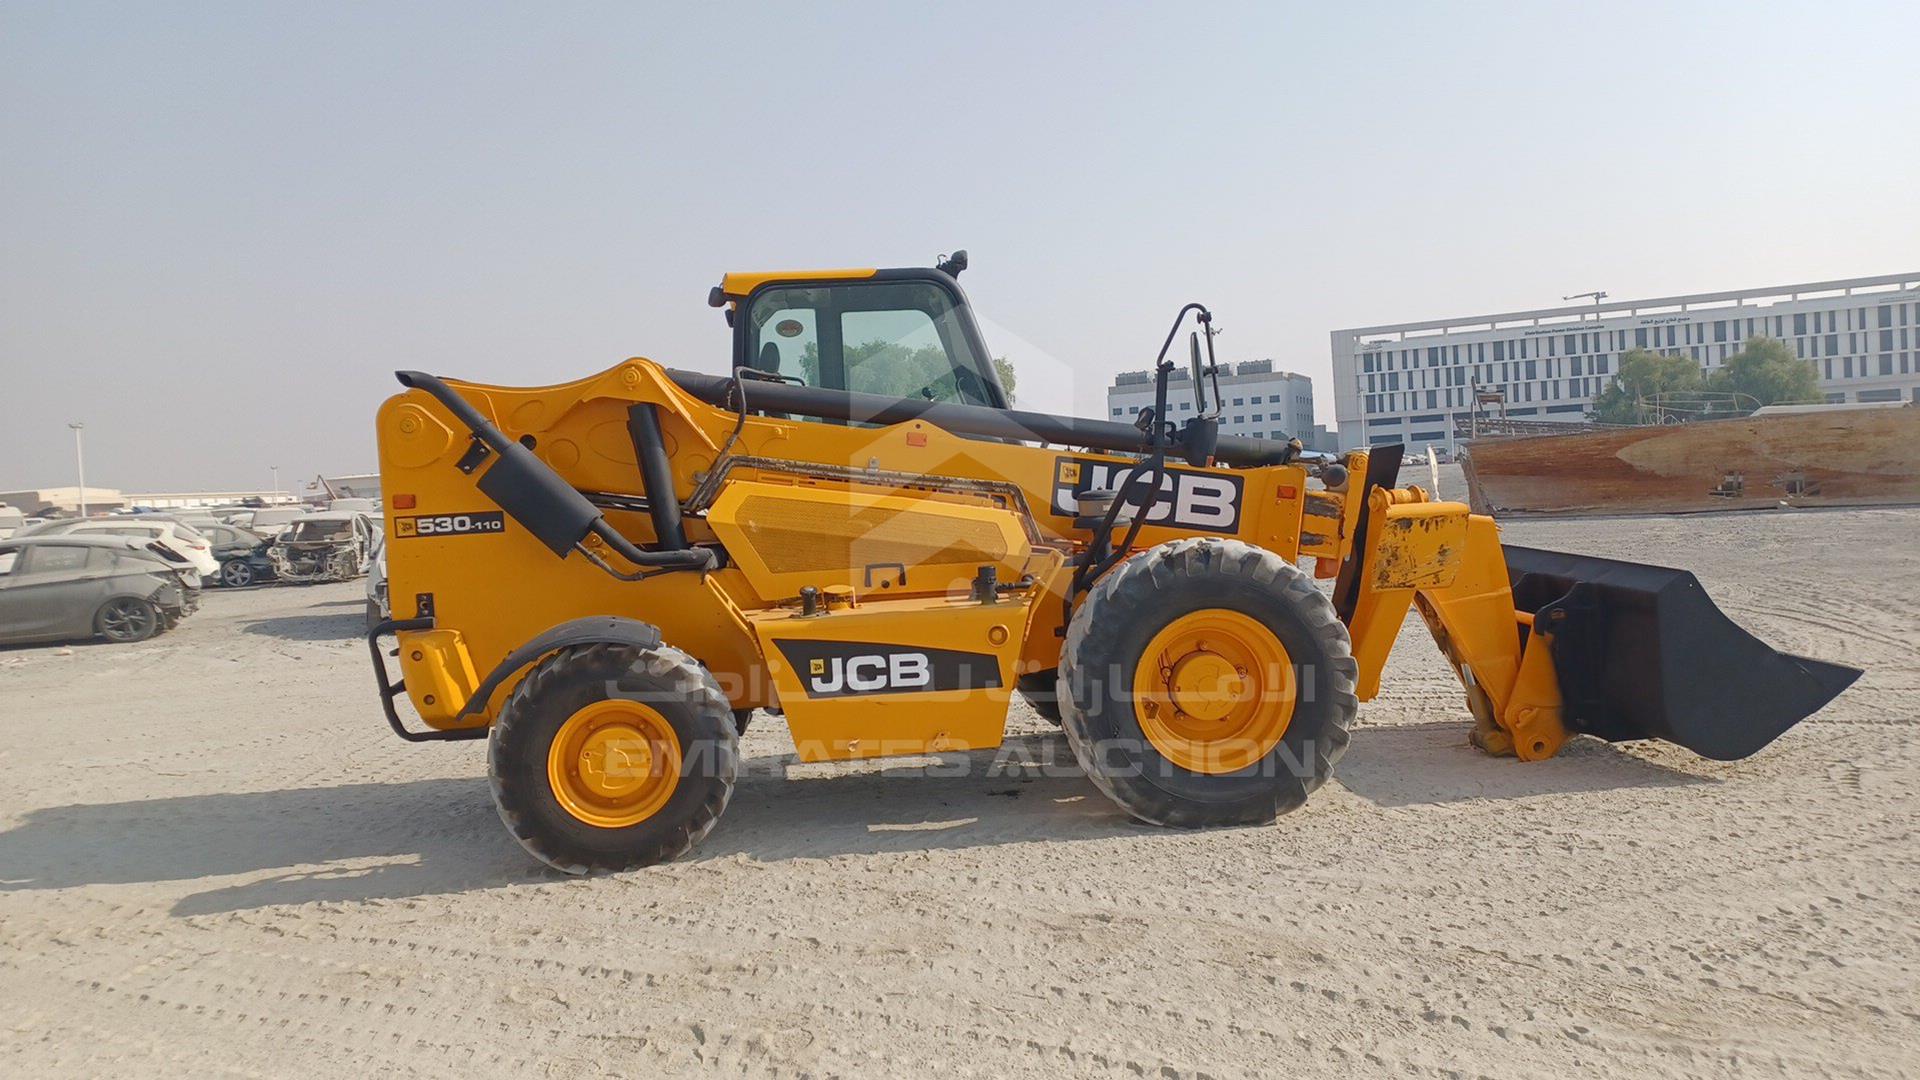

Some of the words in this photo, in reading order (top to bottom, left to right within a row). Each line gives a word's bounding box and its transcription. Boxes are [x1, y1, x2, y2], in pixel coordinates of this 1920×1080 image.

[1057, 465, 1237, 528] JCB
[417, 516, 501, 534] 530-110
[811, 653, 930, 693] JCB
